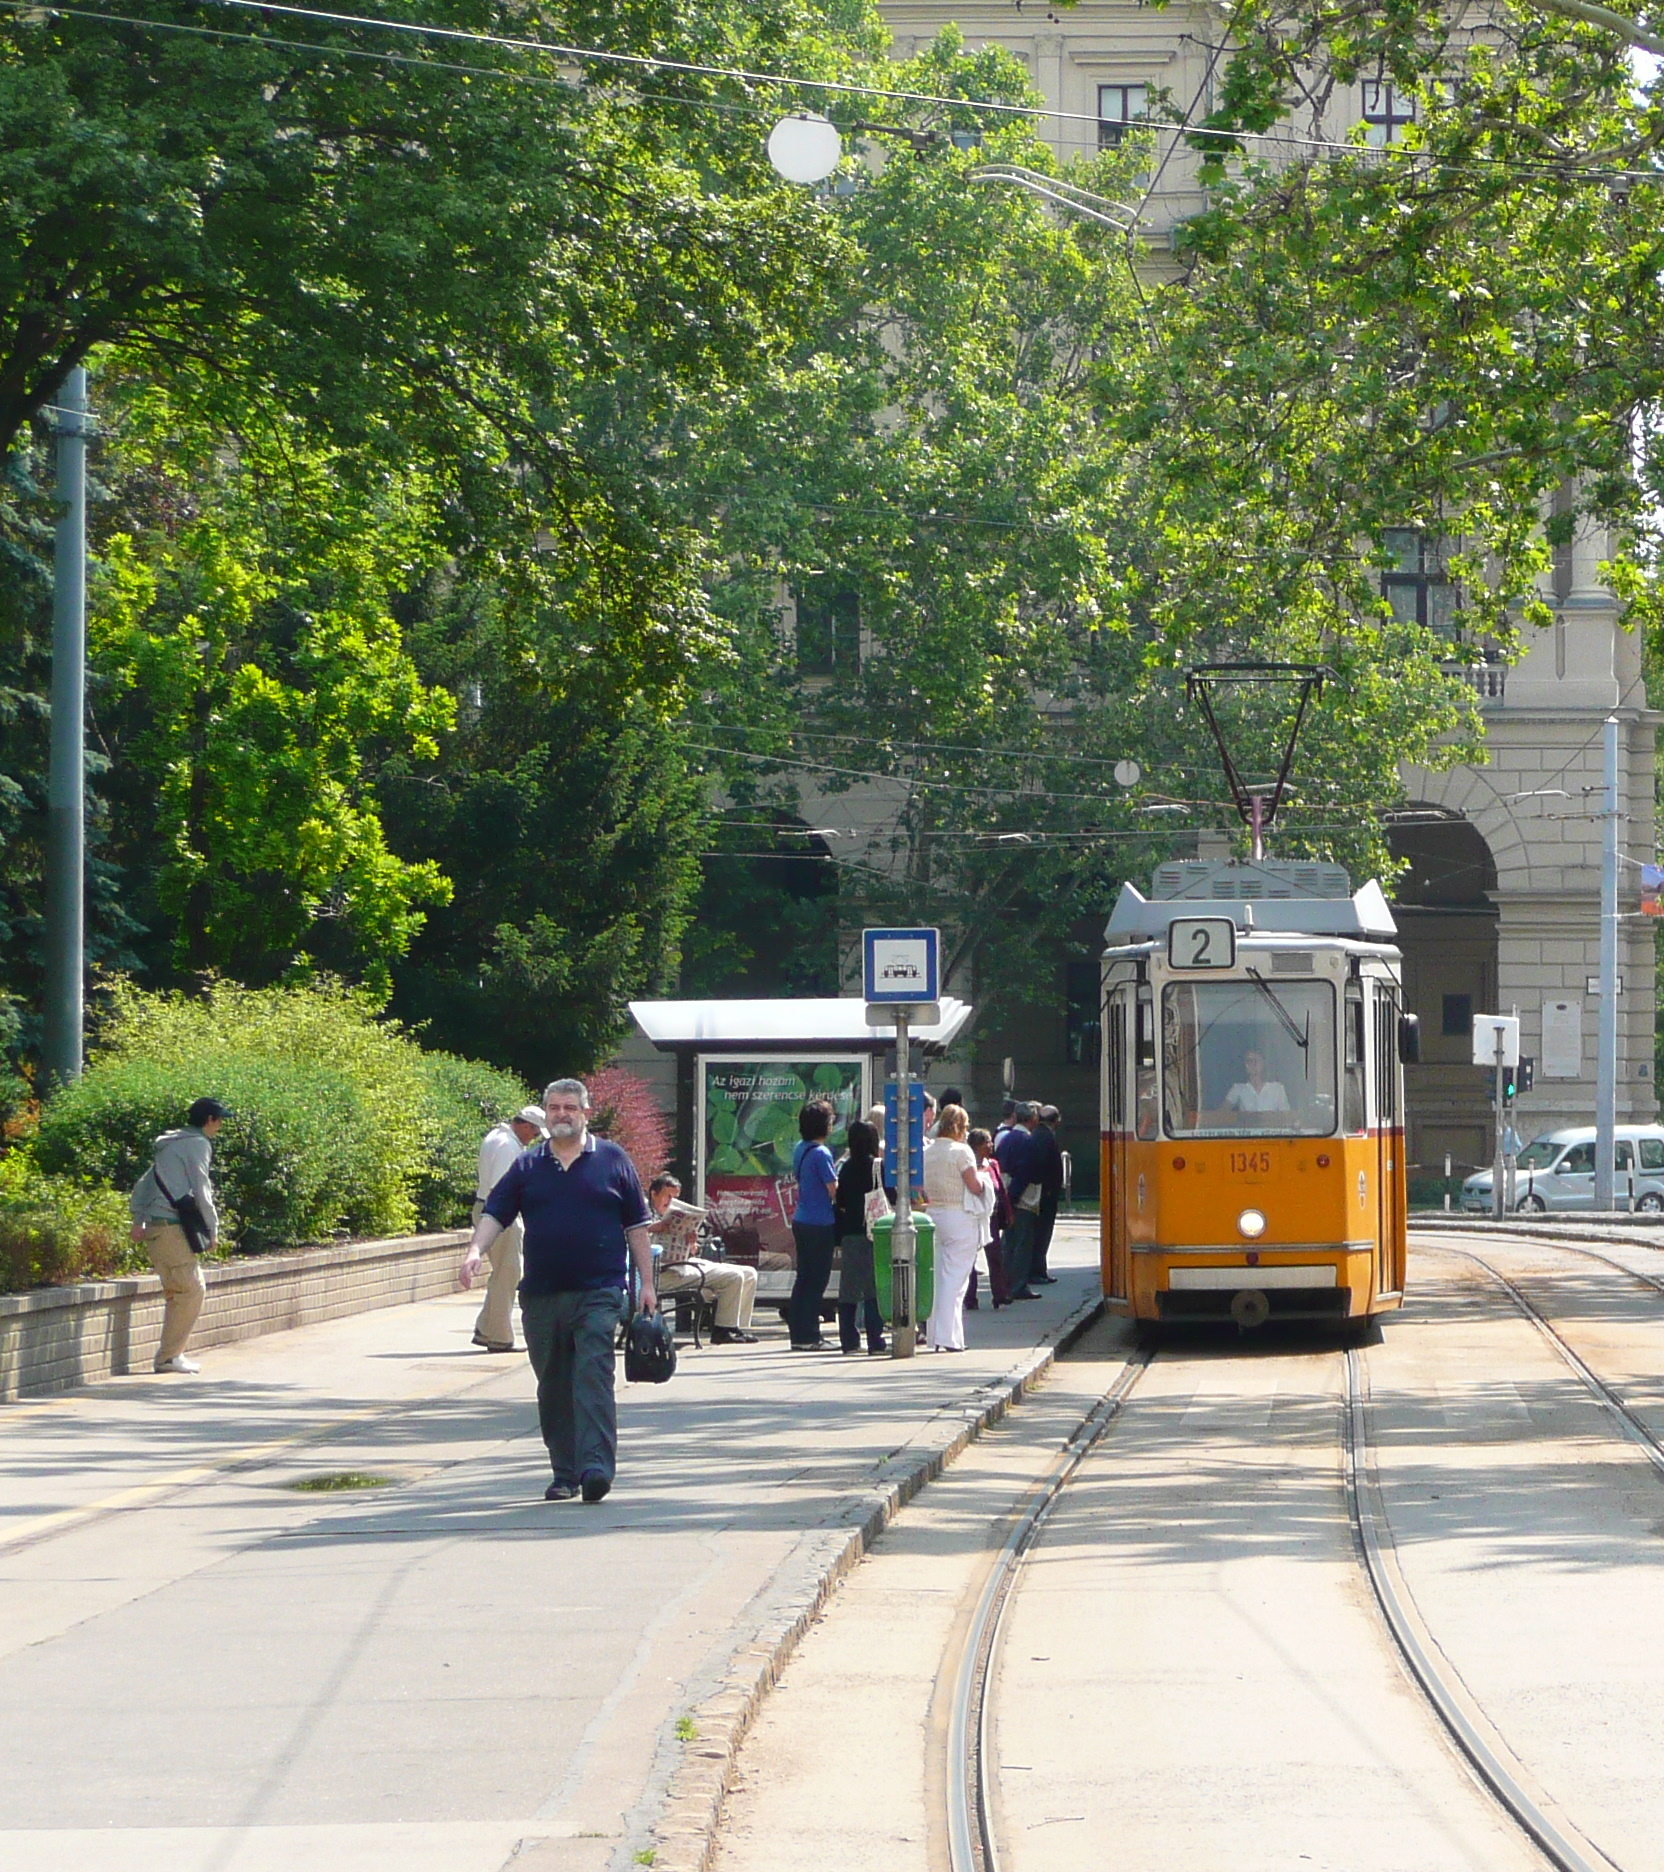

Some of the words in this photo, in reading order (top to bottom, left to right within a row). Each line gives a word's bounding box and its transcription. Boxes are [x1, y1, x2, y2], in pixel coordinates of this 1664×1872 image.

[1191, 928, 1212, 965] 2
[712, 1075, 726, 1086] Az
[729, 1074, 755, 1089] igazi
[758, 1075, 796, 1086] hozam
[724, 1091, 749, 1100] nem
[751, 1091, 806, 1100] szerencse
[1229, 1151, 1271, 1173] 1345
